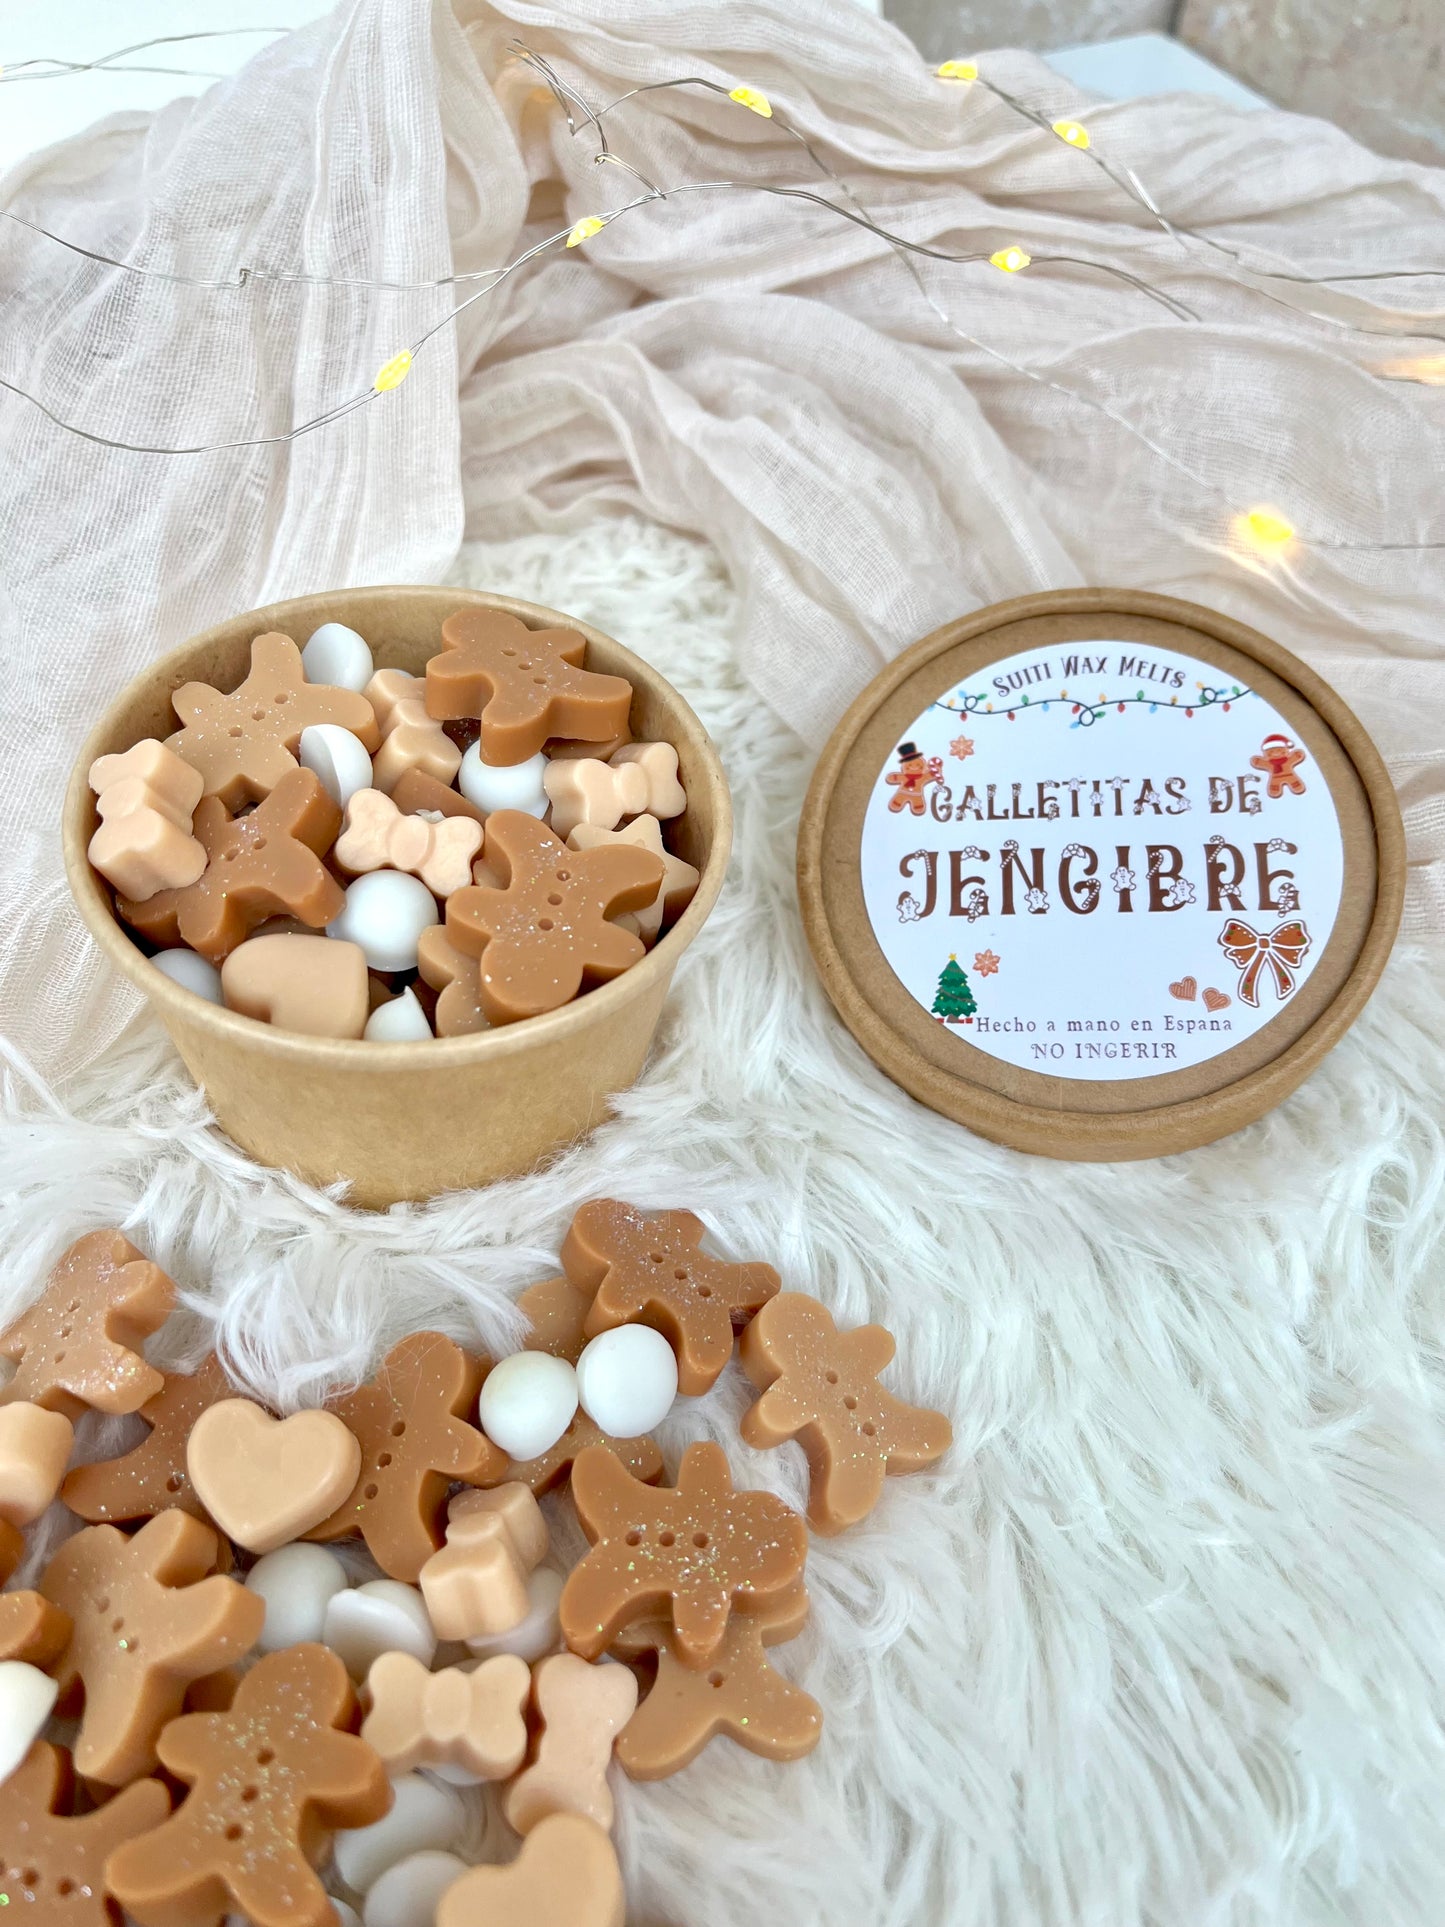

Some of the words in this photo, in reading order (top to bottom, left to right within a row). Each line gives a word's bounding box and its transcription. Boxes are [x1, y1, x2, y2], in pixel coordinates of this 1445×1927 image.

[992, 662, 1052, 697] SUITI
[1060, 655, 1108, 679] WAX
[1118, 655, 1186, 689] MELTS
[930, 776, 1191, 823] GALLETITAS
[1208, 774, 1263, 816] DE
[897, 834, 1301, 924] JENGIBRE
[976, 1017, 1037, 1033] Hecho
[1046, 1021, 1056, 1031] a
[1067, 1019, 1121, 1032] mano
[1130, 1019, 1153, 1031] en
[1030, 1043, 1065, 1060] NO
[1075, 1042, 1178, 1059] INGERIR
